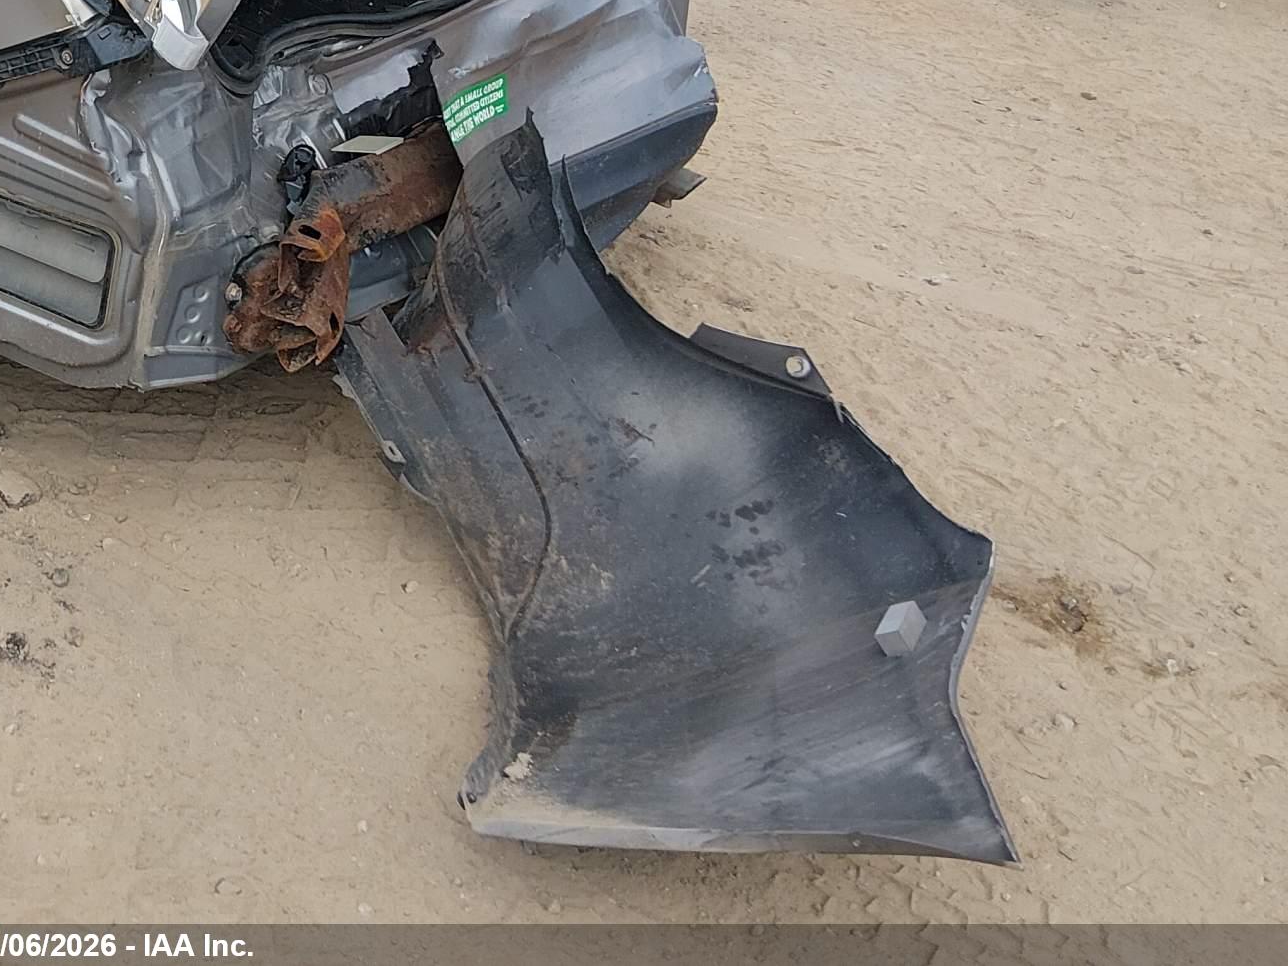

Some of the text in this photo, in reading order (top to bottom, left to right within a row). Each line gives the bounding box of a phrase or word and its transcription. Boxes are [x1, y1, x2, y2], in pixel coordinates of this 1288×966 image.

[464, 88, 484, 103] SMALL
[483, 78, 503, 94] GROUP
[480, 89, 504, 107] CITIZENS
[463, 117, 474, 134] THE
[473, 105, 495, 126] WORLD
